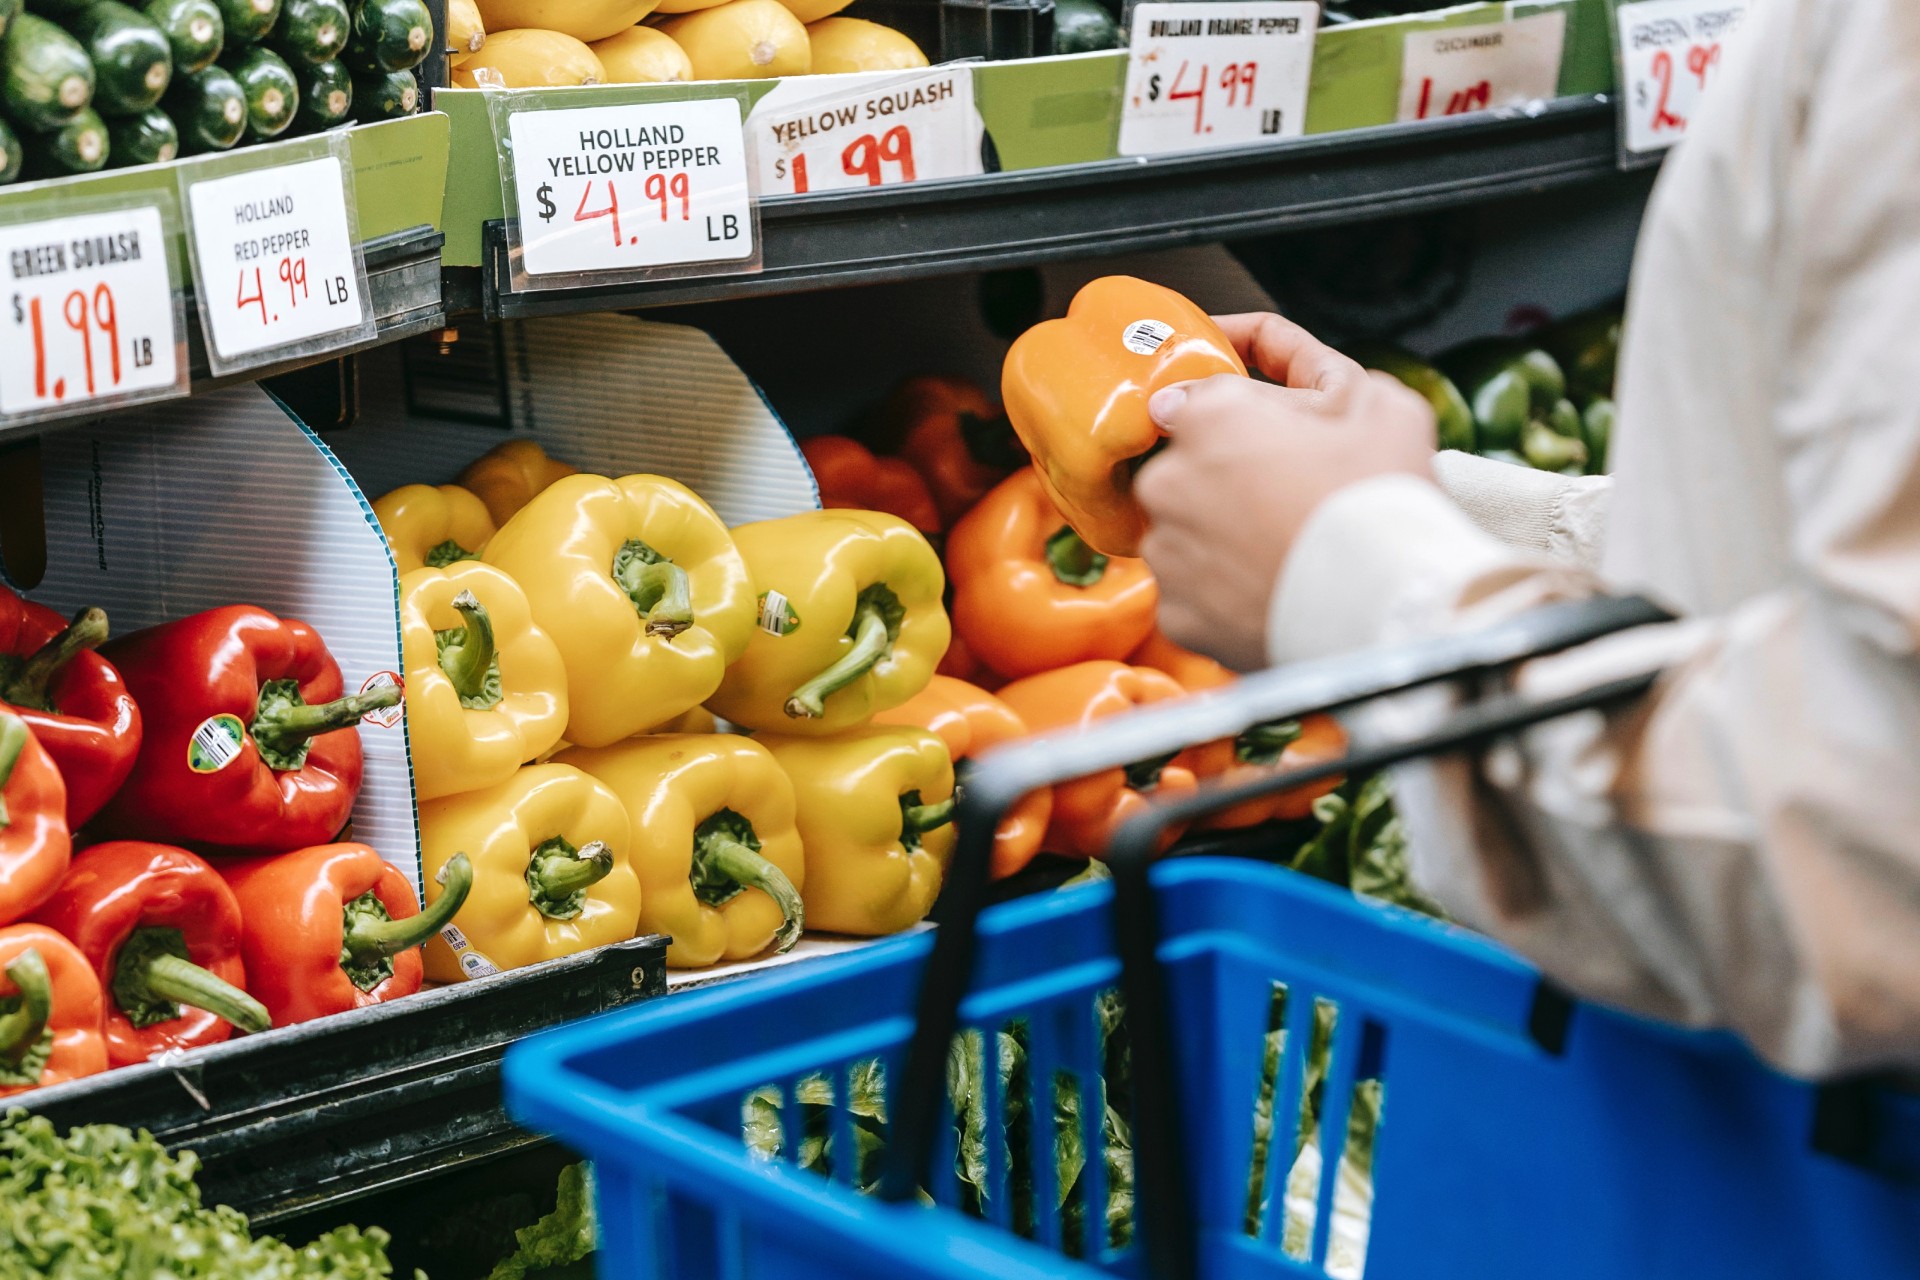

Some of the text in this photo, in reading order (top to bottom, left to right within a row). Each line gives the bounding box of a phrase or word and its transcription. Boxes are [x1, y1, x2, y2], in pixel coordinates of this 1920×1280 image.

[772, 79, 953, 143] YELLOW SQUASH
[1262, 110, 1282, 134] LB
[579, 125, 684, 150] HOLLAND
[548, 147, 721, 177] YELLOW PEPPER
[235, 195, 294, 224] HOLLAND
[706, 214, 739, 241] LB
[11, 230, 142, 279] GREEN SQUASH
[234, 229, 310, 262] RED PEPPER
[237, 256, 348, 325] 4.99 LB
[134, 337, 153, 367] LB
